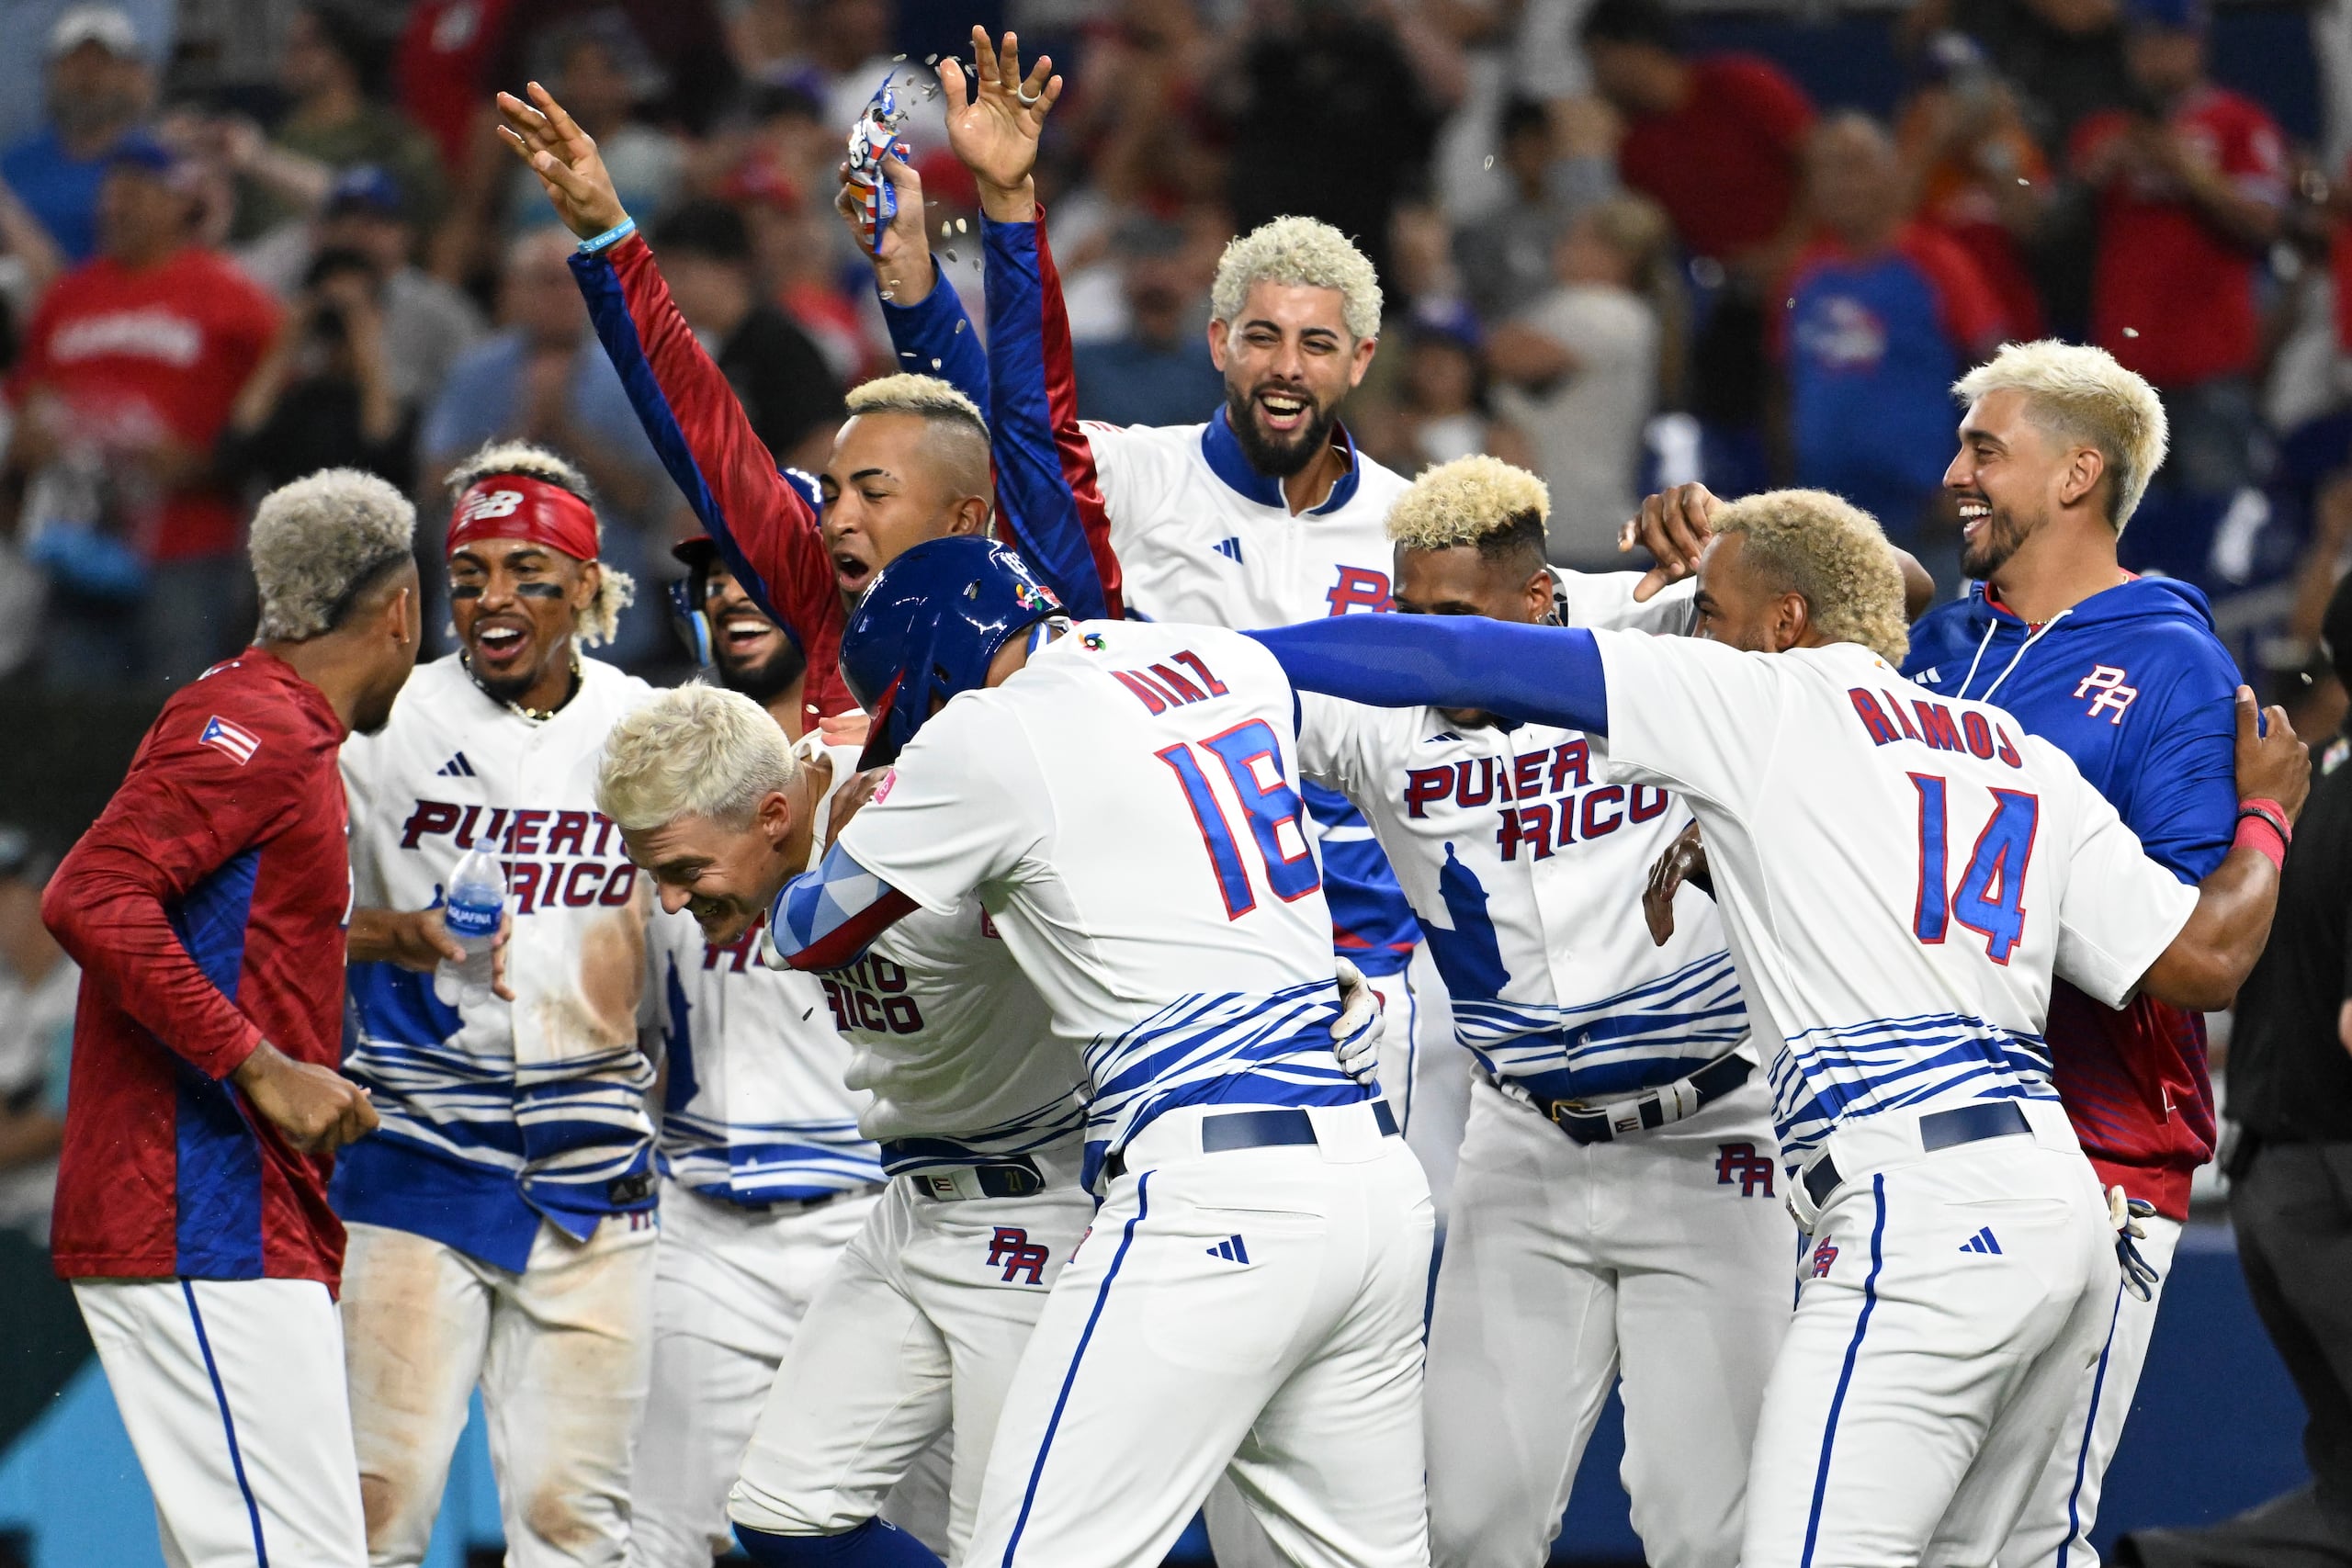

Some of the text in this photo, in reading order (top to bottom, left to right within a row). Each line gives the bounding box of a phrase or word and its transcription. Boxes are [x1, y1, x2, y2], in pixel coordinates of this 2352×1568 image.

[1108, 649, 1230, 716] DIAZ
[2072, 663, 2139, 726] PR
[1153, 717, 1321, 922] 18
[1496, 784, 1668, 862] RICO
[1905, 771, 2040, 967] 14
[1714, 1142, 1777, 1198] PR
[986, 1226, 1051, 1285] PR
